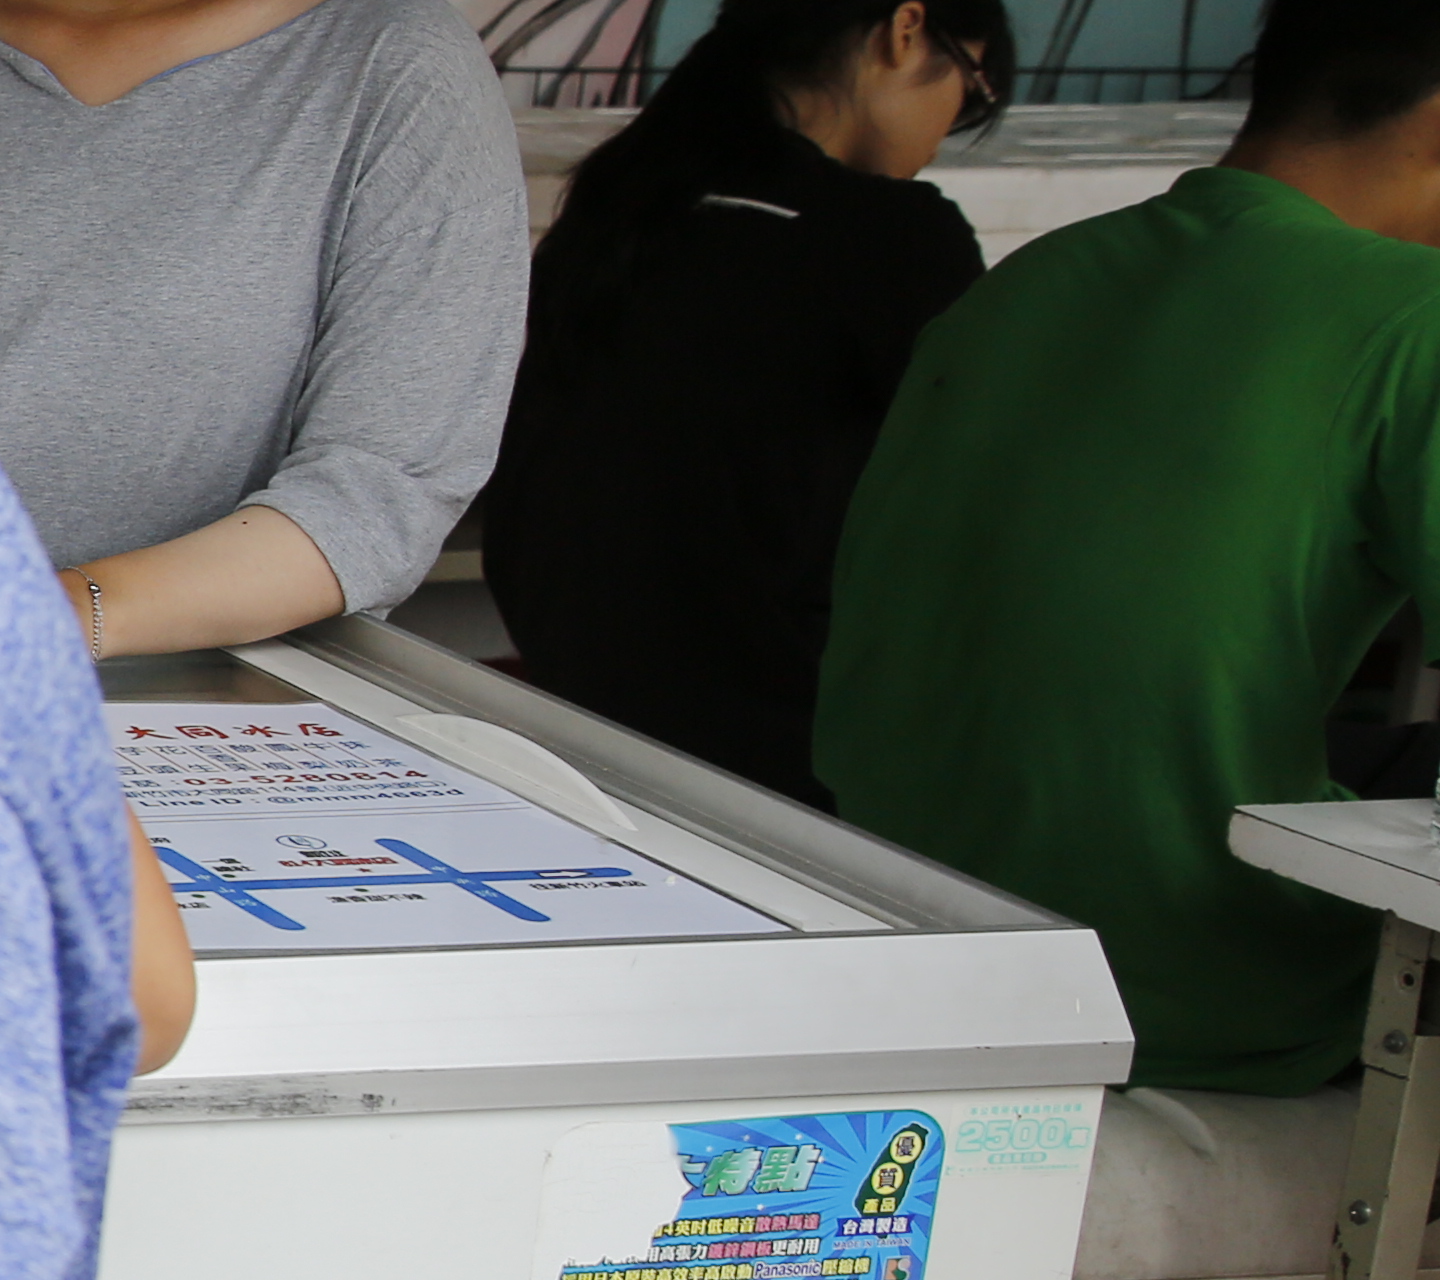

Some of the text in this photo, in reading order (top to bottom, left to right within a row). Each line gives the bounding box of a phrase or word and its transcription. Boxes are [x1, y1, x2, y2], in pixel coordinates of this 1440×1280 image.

[124, 722, 345, 740] 大同冰店
[841, 1216, 910, 1236] 台灣製造
[832, 1239, 862, 1251] MADE
[875, 1236, 912, 1247] TAIWAN
